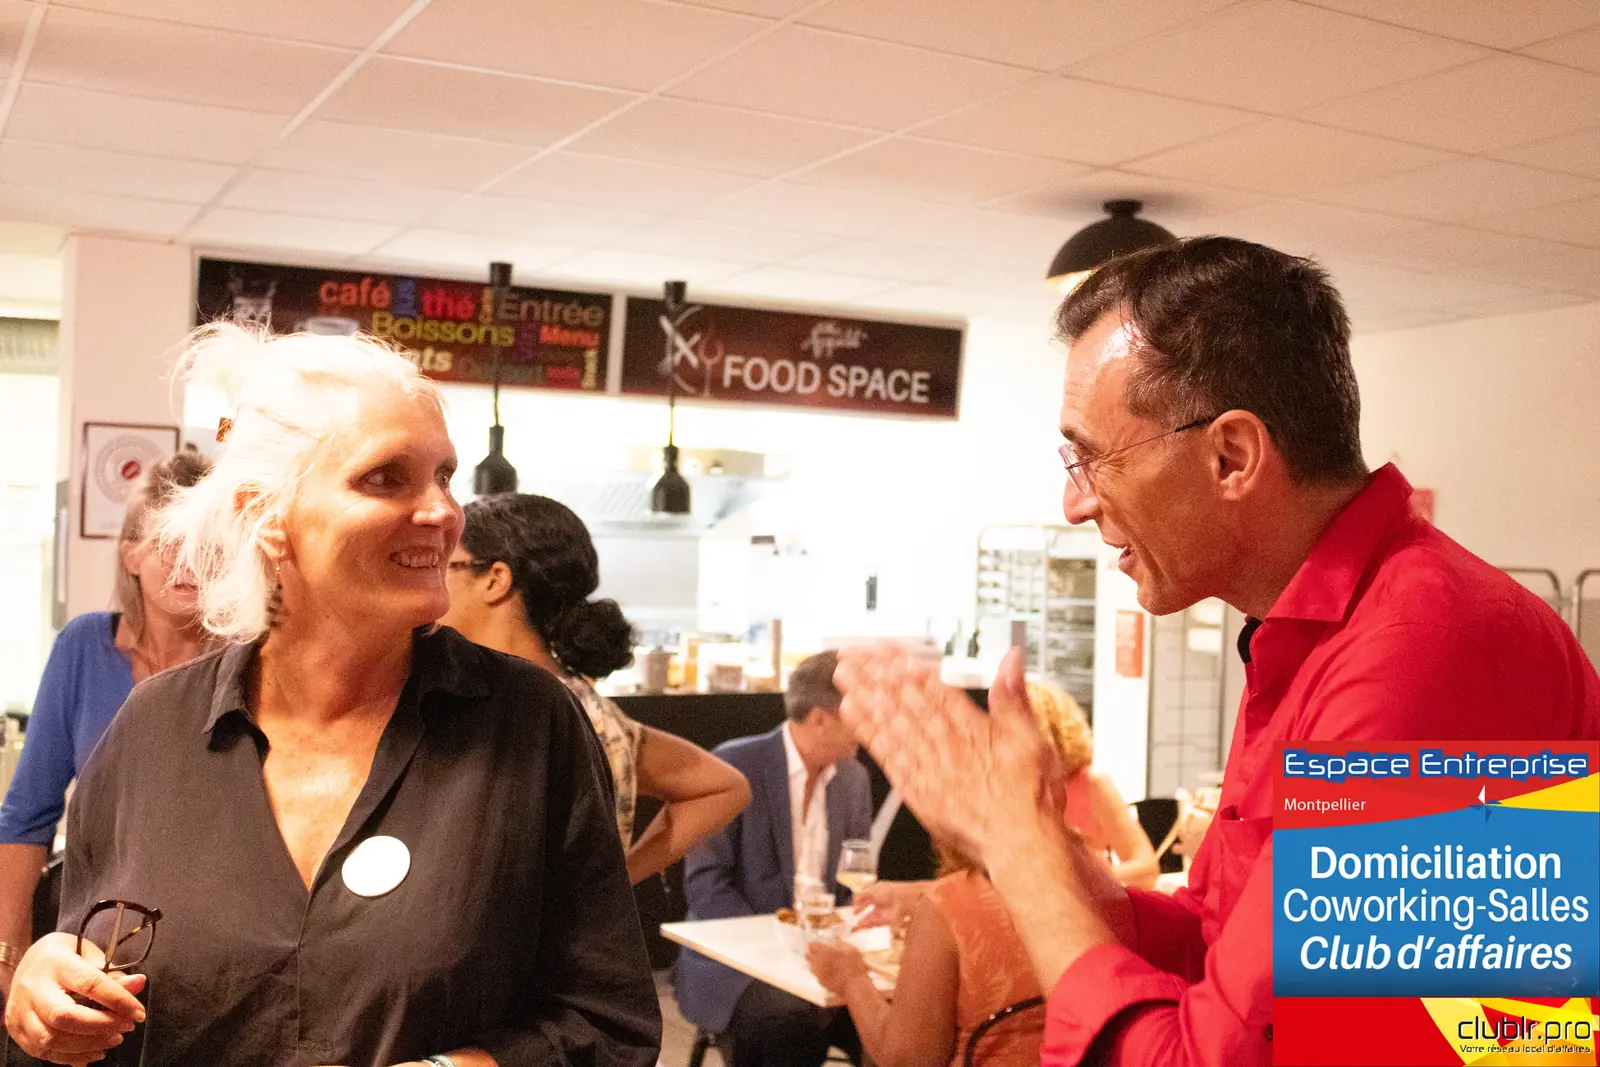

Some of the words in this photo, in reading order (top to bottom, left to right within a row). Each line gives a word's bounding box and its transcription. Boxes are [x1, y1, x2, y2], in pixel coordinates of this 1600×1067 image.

[319, 276, 391, 309] café
[496, 291, 604, 327] Entrée
[371, 311, 516, 347] Boissons
[723, 355, 820, 394] FOOD
[827, 365, 930, 403] SPACE
